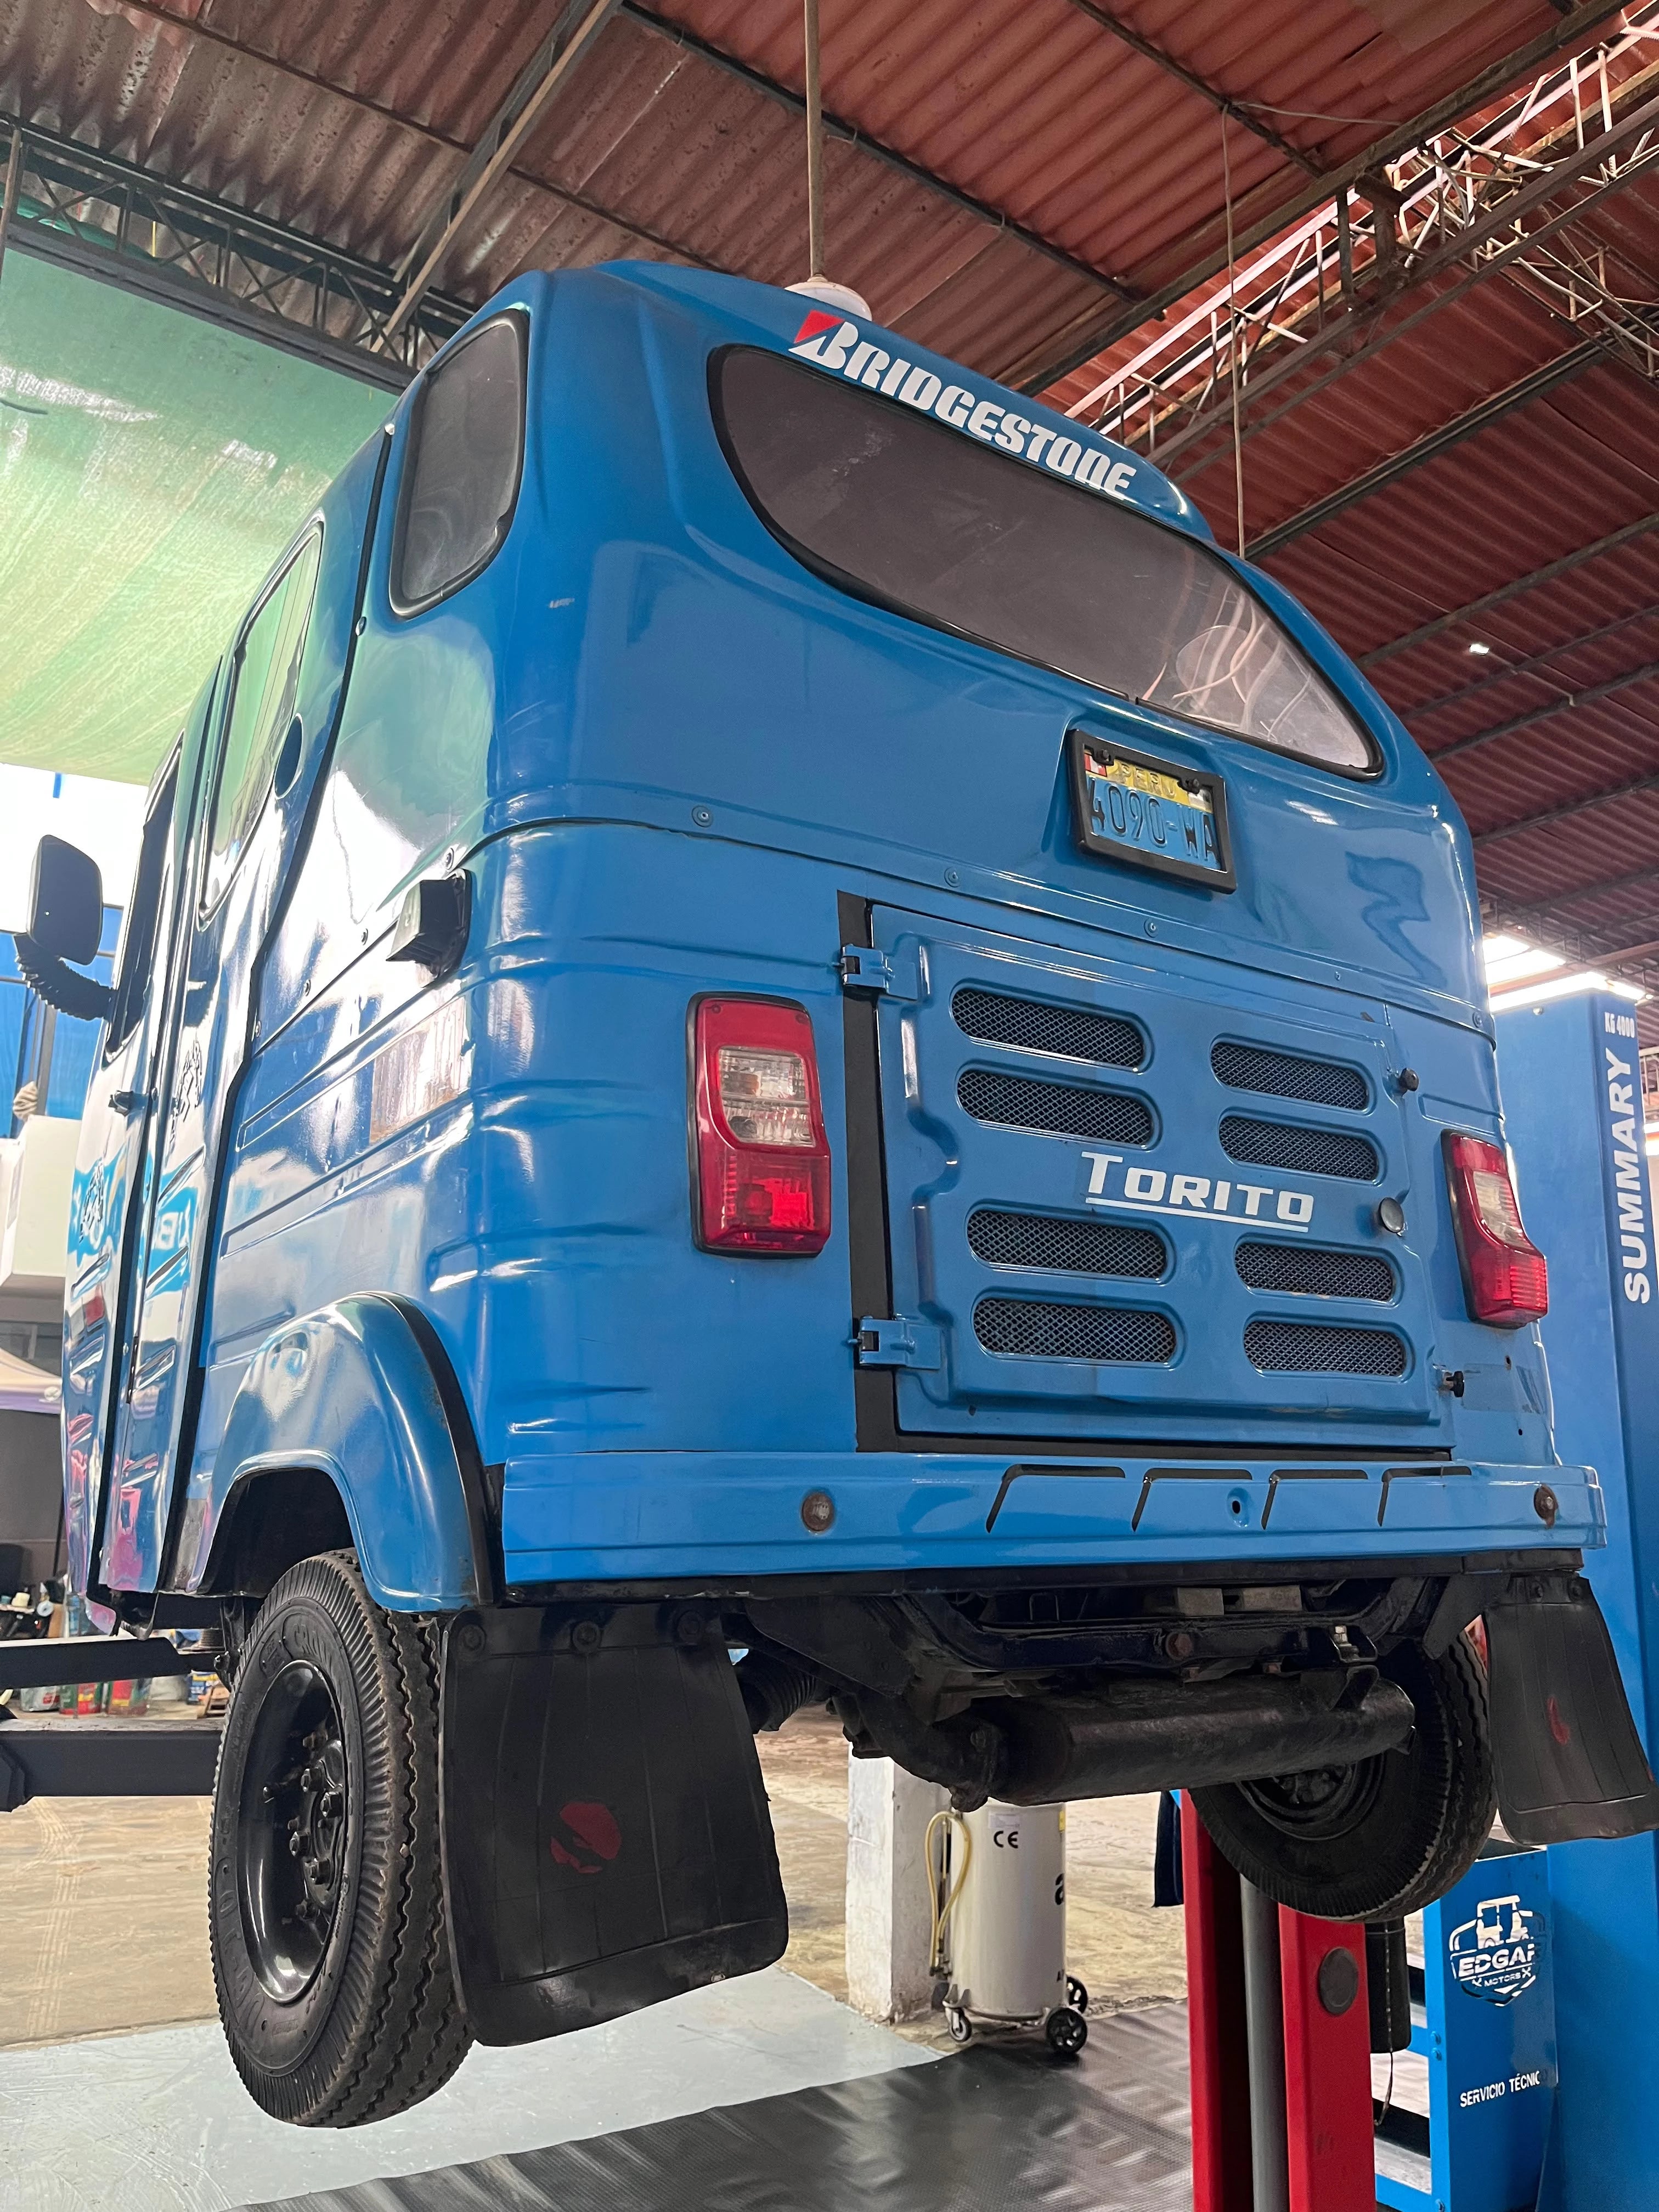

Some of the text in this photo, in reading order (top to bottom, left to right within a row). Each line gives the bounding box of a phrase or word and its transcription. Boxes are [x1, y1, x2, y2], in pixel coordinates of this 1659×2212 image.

[788, 313, 1137, 501] BRIDGESTONE
[1605, 1011, 1635, 1039] KG 4000
[1081, 1151, 1314, 1223] TORITO
[1605, 1047, 1650, 1304] SUMMARY
[994, 1830, 1019, 1849] CE
[1484, 1972, 1521, 1987] MOTORS
[1460, 2081, 1505, 2107] SERVICIO
